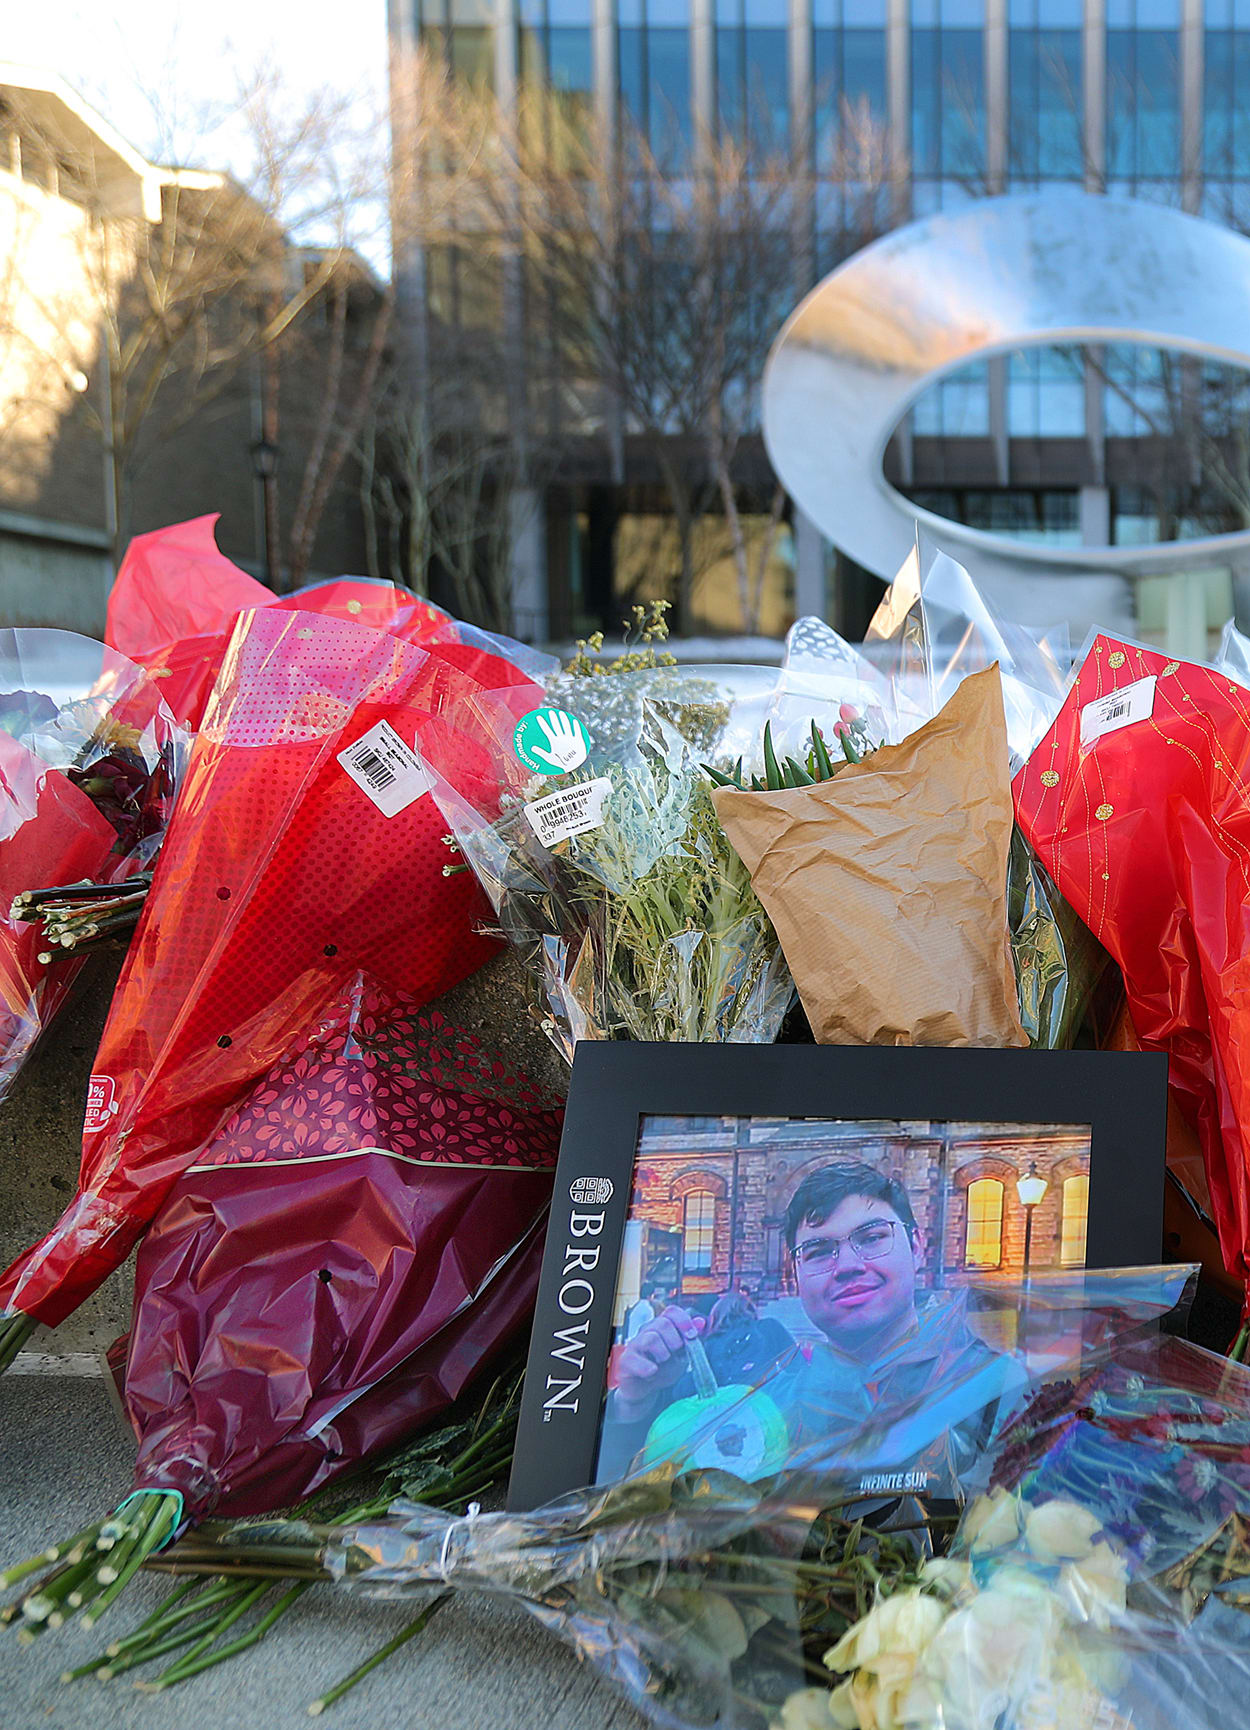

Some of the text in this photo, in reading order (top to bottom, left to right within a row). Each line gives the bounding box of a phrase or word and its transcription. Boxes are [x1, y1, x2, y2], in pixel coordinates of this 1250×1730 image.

[516, 733, 541, 771] Handmade
[533, 786, 593, 814] WHOLE BOUQU
[542, 831, 556, 842] 337
[543, 1210, 606, 1415] BROWN
[860, 1472, 928, 1489] INFINITE SUN
